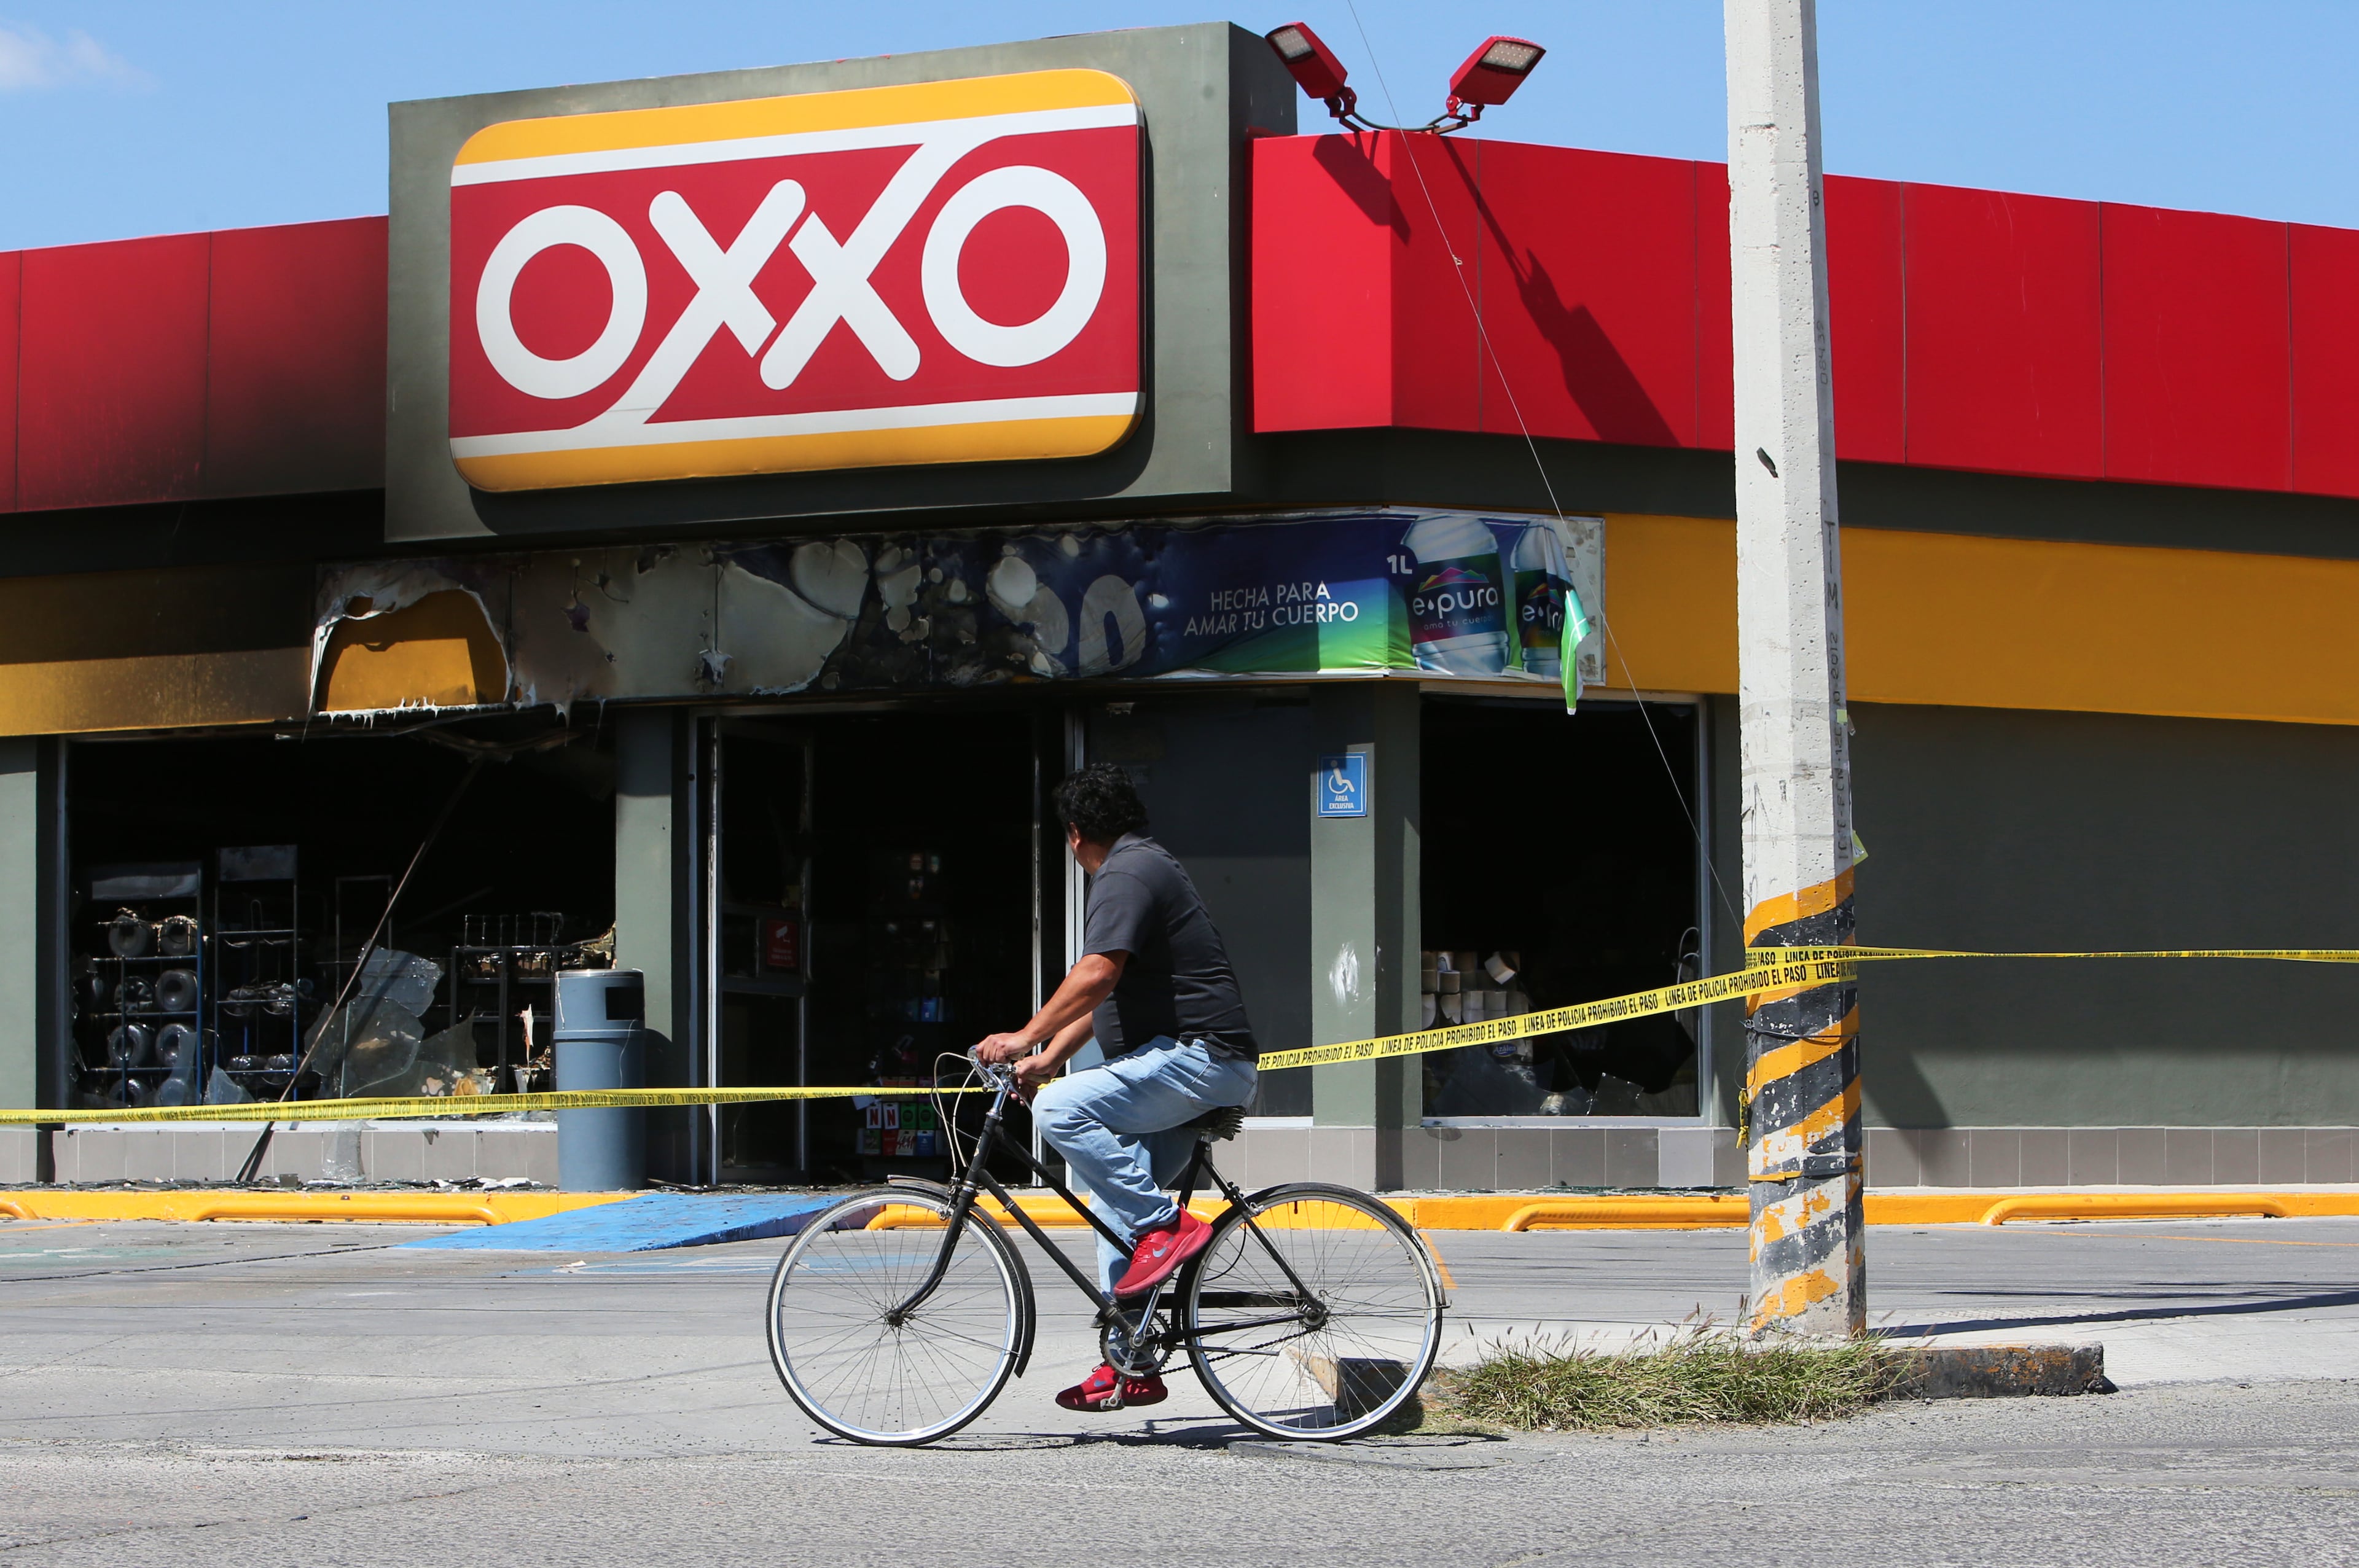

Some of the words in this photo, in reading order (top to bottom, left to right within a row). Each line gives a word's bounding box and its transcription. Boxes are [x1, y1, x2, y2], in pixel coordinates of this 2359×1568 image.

[476, 142, 1107, 425] OXXO
[1387, 555, 1412, 574] 1L
[1211, 586, 1270, 612] HECHA
[1277, 580, 1331, 604] PARA
[1183, 613, 1237, 636] AMAR
[1243, 610, 1264, 631] TU
[1272, 601, 1358, 626] CUERPO
[1785, 951, 1810, 963] LINEA
[1813, 951, 1824, 960] DE
[1259, 1057, 1270, 1069] DE
[1271, 1053, 1301, 1067] POLICIA
[1301, 1047, 1342, 1066] PROHIBIDO
[1344, 1046, 1352, 1059] EL
[1354, 1042, 1374, 1058] PASO
[1380, 1037, 1401, 1055] LINEA
[1403, 1037, 1414, 1051] DE
[1415, 1031, 1444, 1050] POLICIA
[1446, 1025, 1485, 1045] PROHIBIDO
[1487, 1024, 1495, 1039] EL
[1498, 1020, 1516, 1037] PASO
[1524, 1015, 1544, 1033] LINEA
[1547, 1013, 1555, 1029] DE
[1557, 1007, 1586, 1027] POLICIA
[1587, 999, 1627, 1021] PROHIBIDO
[1629, 997, 1638, 1013] EL
[1639, 993, 1658, 1012] PASO
[1665, 989, 1686, 1007] LINEA
[1688, 986, 1697, 1002] DE
[1699, 978, 1727, 999] POLICIA
[1729, 970, 1769, 993] PROHIBIDO
[1771, 969, 1782, 985] EL
[1785, 964, 1807, 983] PASO
[1816, 962, 1840, 979] LINEA
[870, 1109, 878, 1125] N
[887, 1109, 896, 1126] N
